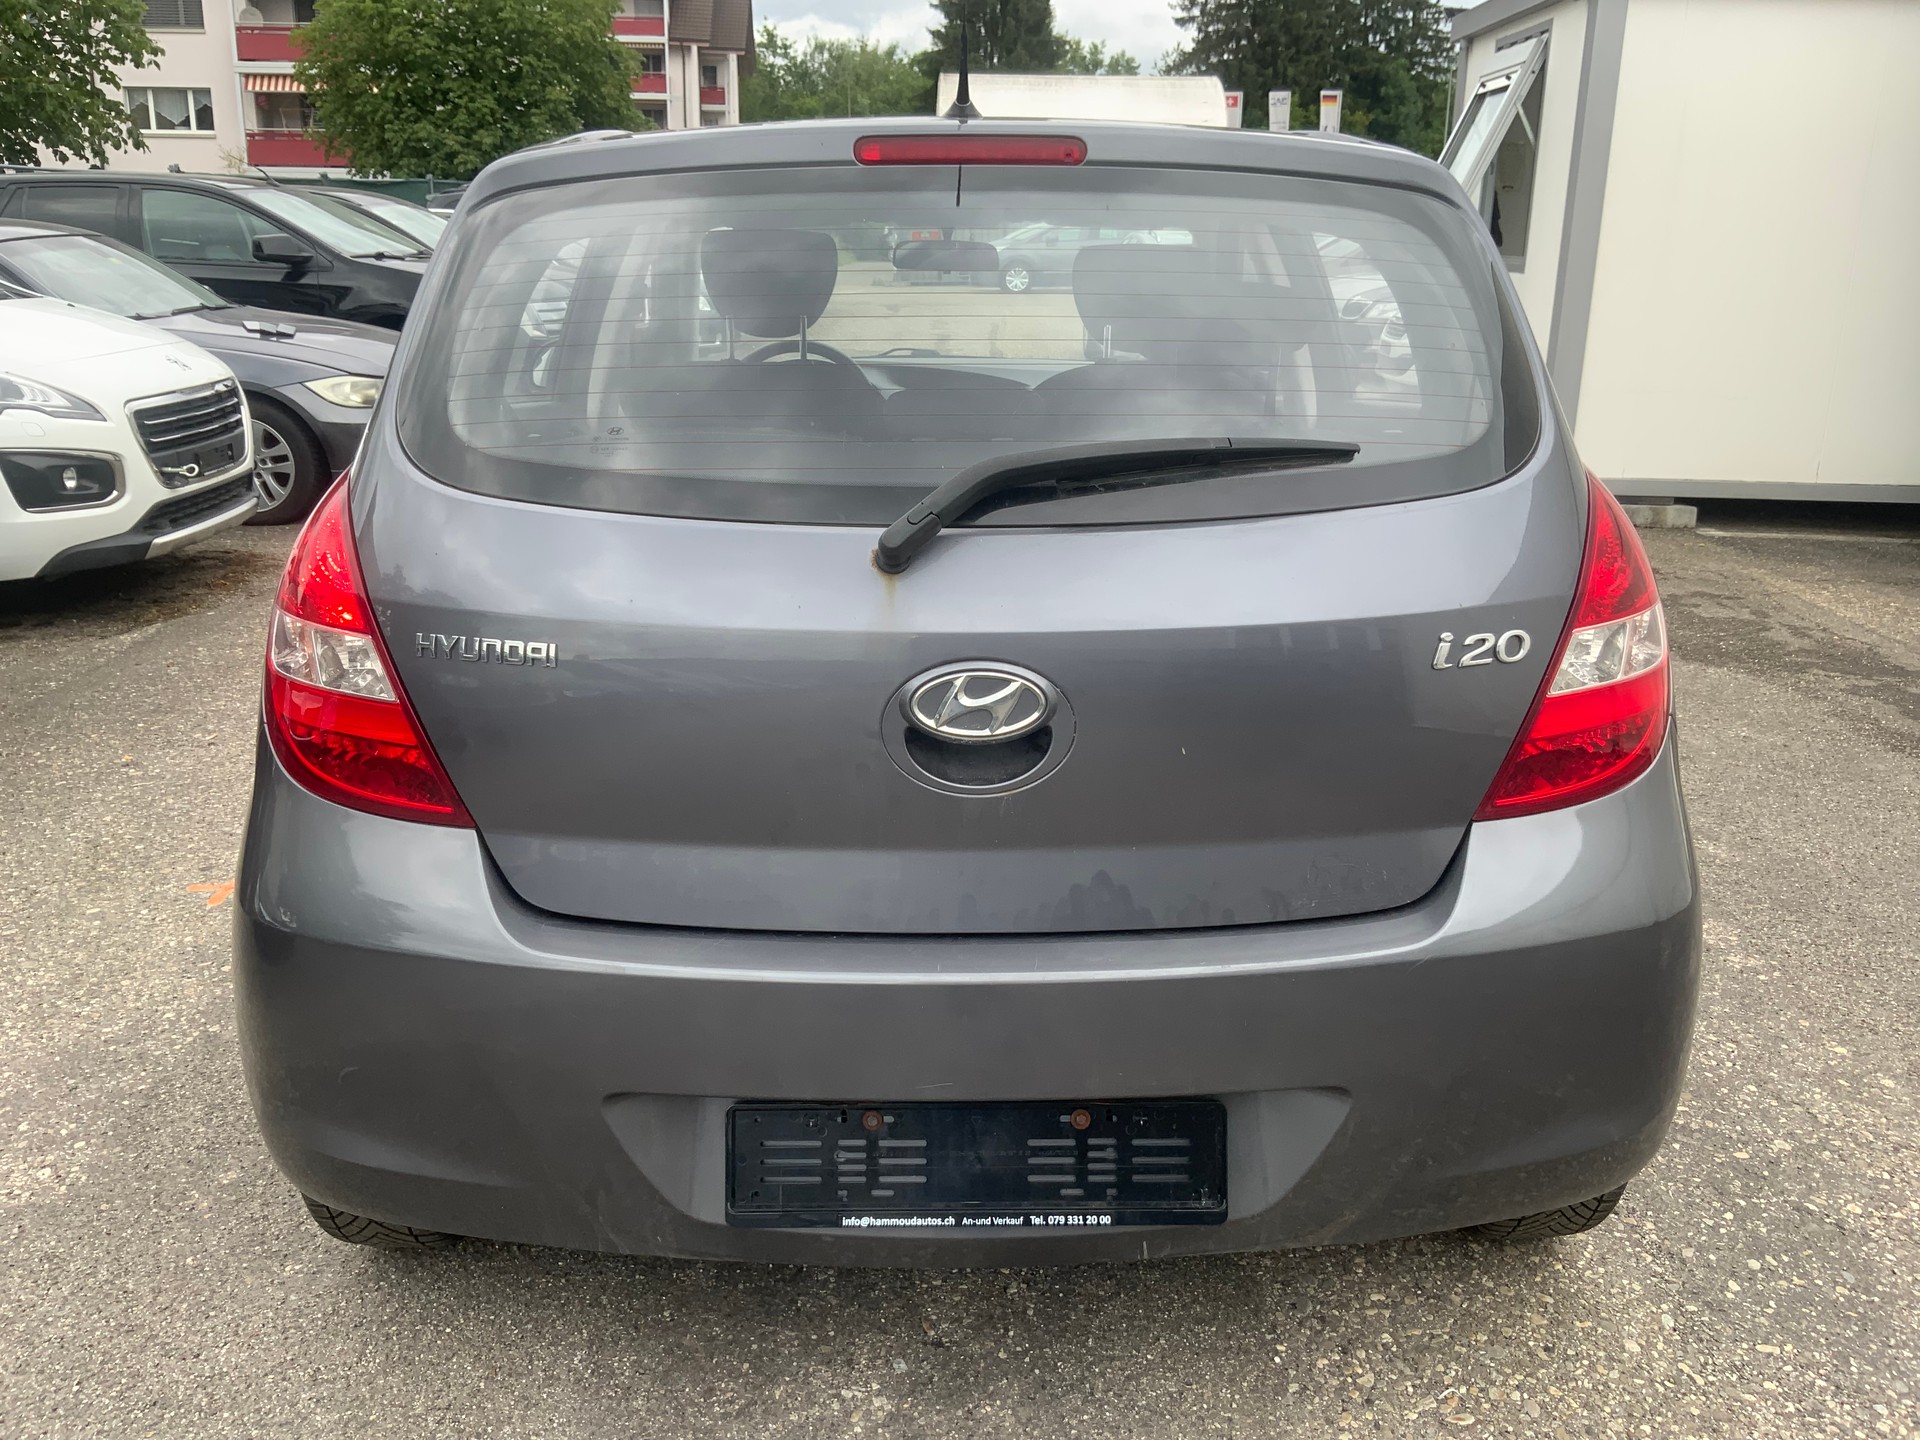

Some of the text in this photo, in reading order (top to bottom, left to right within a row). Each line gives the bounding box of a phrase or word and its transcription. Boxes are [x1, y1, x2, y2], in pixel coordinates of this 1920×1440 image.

[415, 632, 558, 668] HYUNDAI
[1432, 629, 1531, 670] i20
[842, 1216, 956, 1227] info@hammoudautos.ch
[993, 1216, 1024, 1225] Verkauf
[1030, 1215, 1046, 1225] Tel.
[1048, 1215, 1065, 1225] 079
[1067, 1215, 1084, 1225] 331
[1086, 1215, 1098, 1225] 20
[1100, 1215, 1112, 1225] 00
